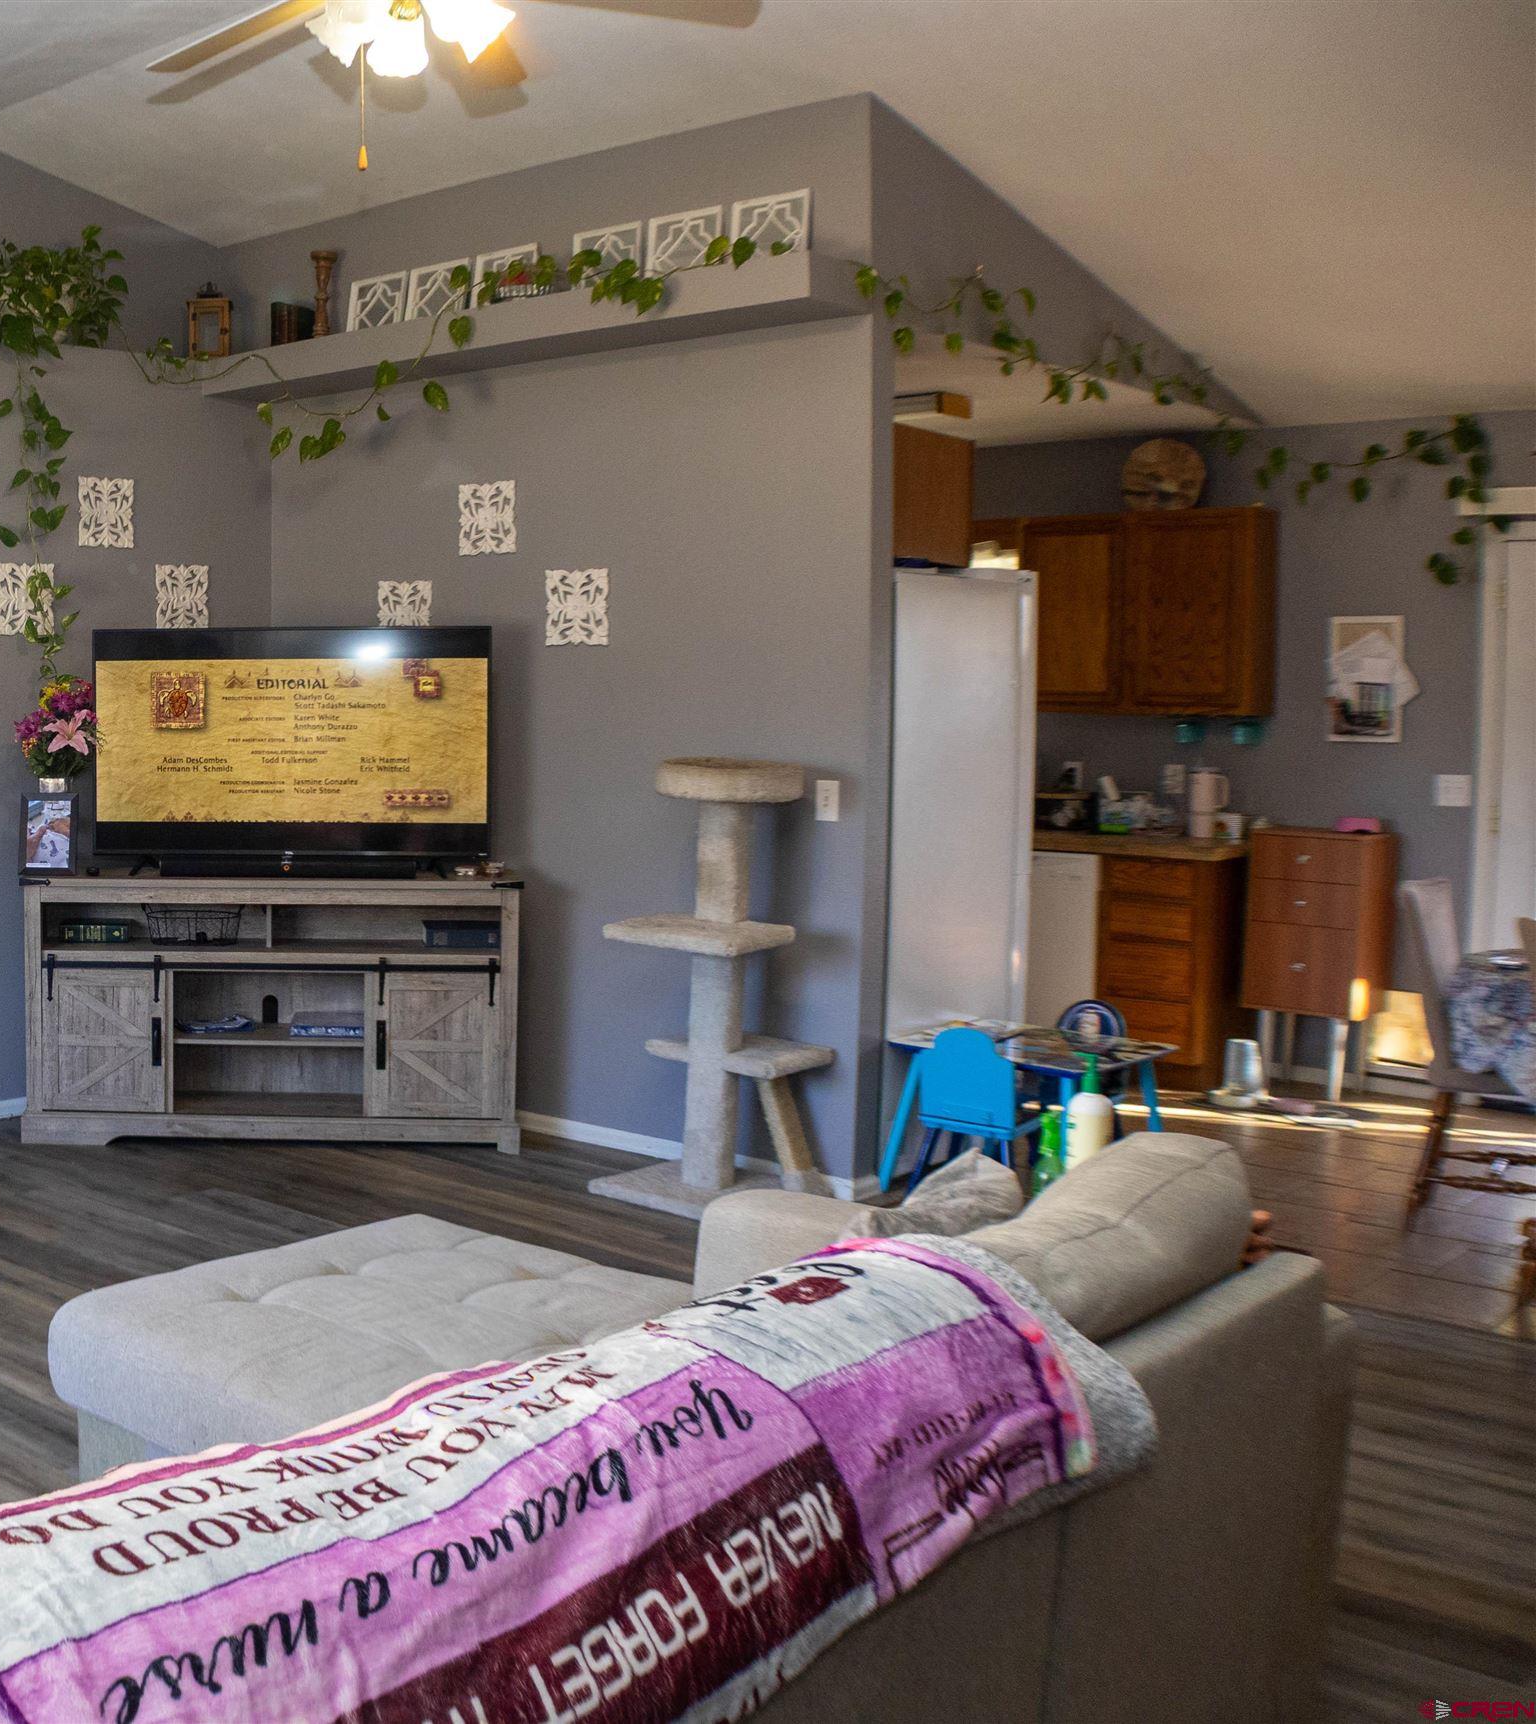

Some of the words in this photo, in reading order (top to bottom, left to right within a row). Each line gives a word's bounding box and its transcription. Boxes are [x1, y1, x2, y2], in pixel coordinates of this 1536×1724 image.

[257, 678, 328, 690] EDITORIAL
[324, 693, 335, 701] Go
[293, 723, 325, 731] Anthony
[293, 735, 314, 743] Brian
[316, 734, 346, 742] Millman
[162, 756, 184, 764] Adam
[186, 756, 228, 764] DesCombes
[261, 756, 280, 764] Todd
[282, 756, 318, 764] Fulkerson
[360, 756, 376, 764] Rick
[378, 756, 410, 764] Hammel
[157, 765, 191, 773] Hermann
[203, 765, 233, 773] Schmidt
[359, 765, 374, 773] Eric
[376, 765, 410, 773] Whitfield
[293, 778, 322, 786] Jasmine
[293, 787, 317, 795] Nicole
[319, 787, 341, 795] Stone
[636, 1379, 755, 1460] You
[406, 1415, 516, 1488] YOU
[118, 1474, 260, 1521] YOU
[317, 1476, 408, 1522] BE
[412, 1448, 628, 1590] became
[92, 1497, 320, 1576] PROUD
[706, 1481, 844, 1598] NEVER
[339, 1573, 392, 1618] a
[528, 1573, 709, 1724] FORGET
[100, 1599, 318, 1724] nurse
